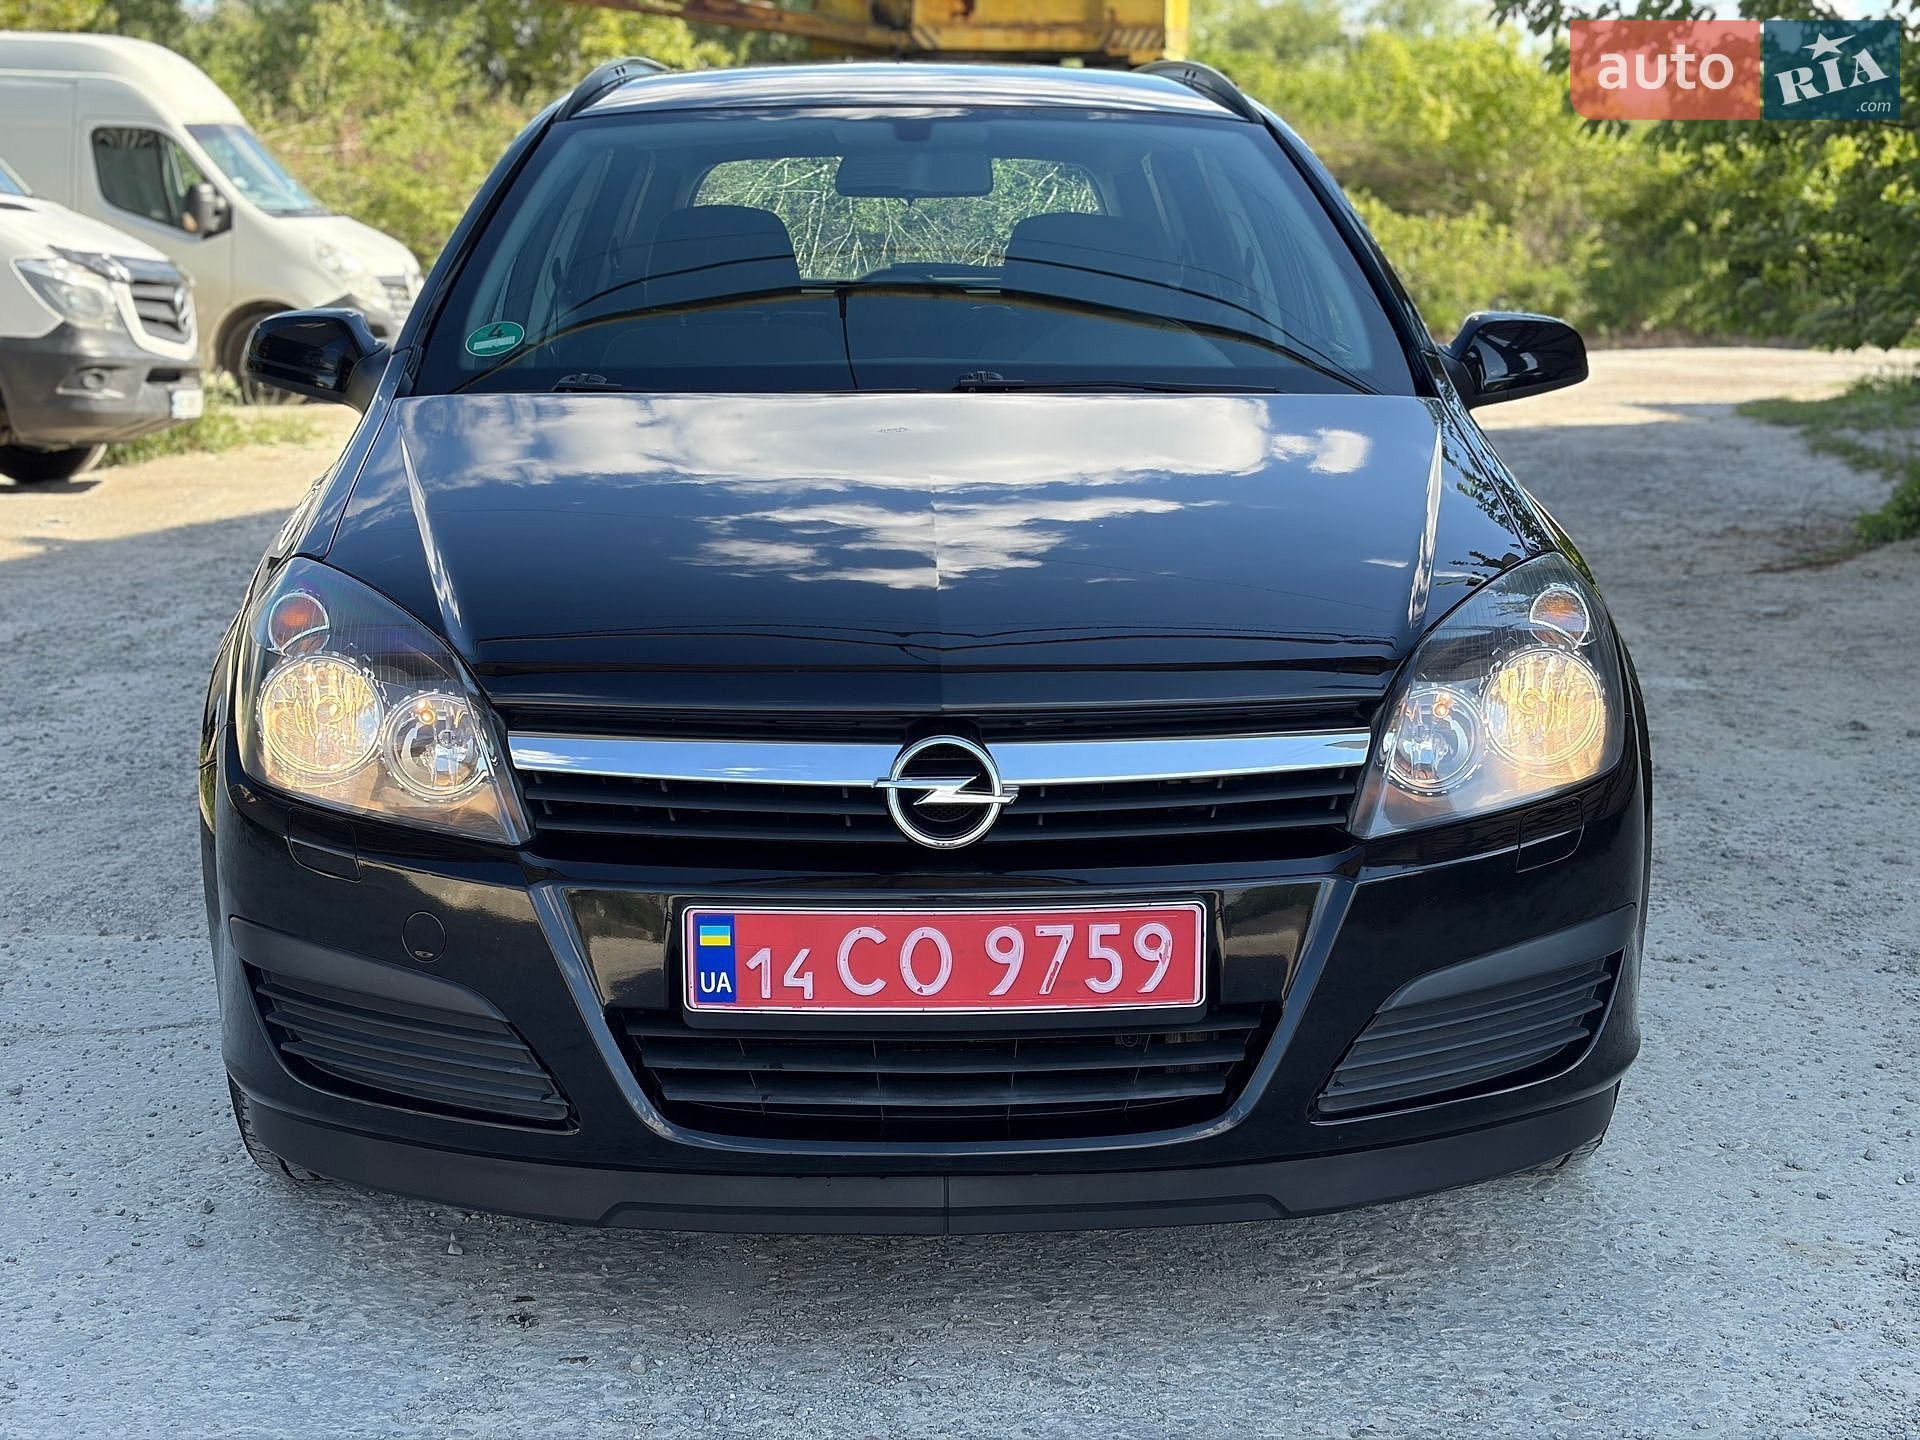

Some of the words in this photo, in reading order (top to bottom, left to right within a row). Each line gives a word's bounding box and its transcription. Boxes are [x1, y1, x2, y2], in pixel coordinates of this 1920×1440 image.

[489, 324, 505, 338] 4
[746, 948, 814, 1000] 14
[837, 926, 952, 996] CO
[985, 923, 1174, 995] 9759
[700, 971, 733, 993] UA
